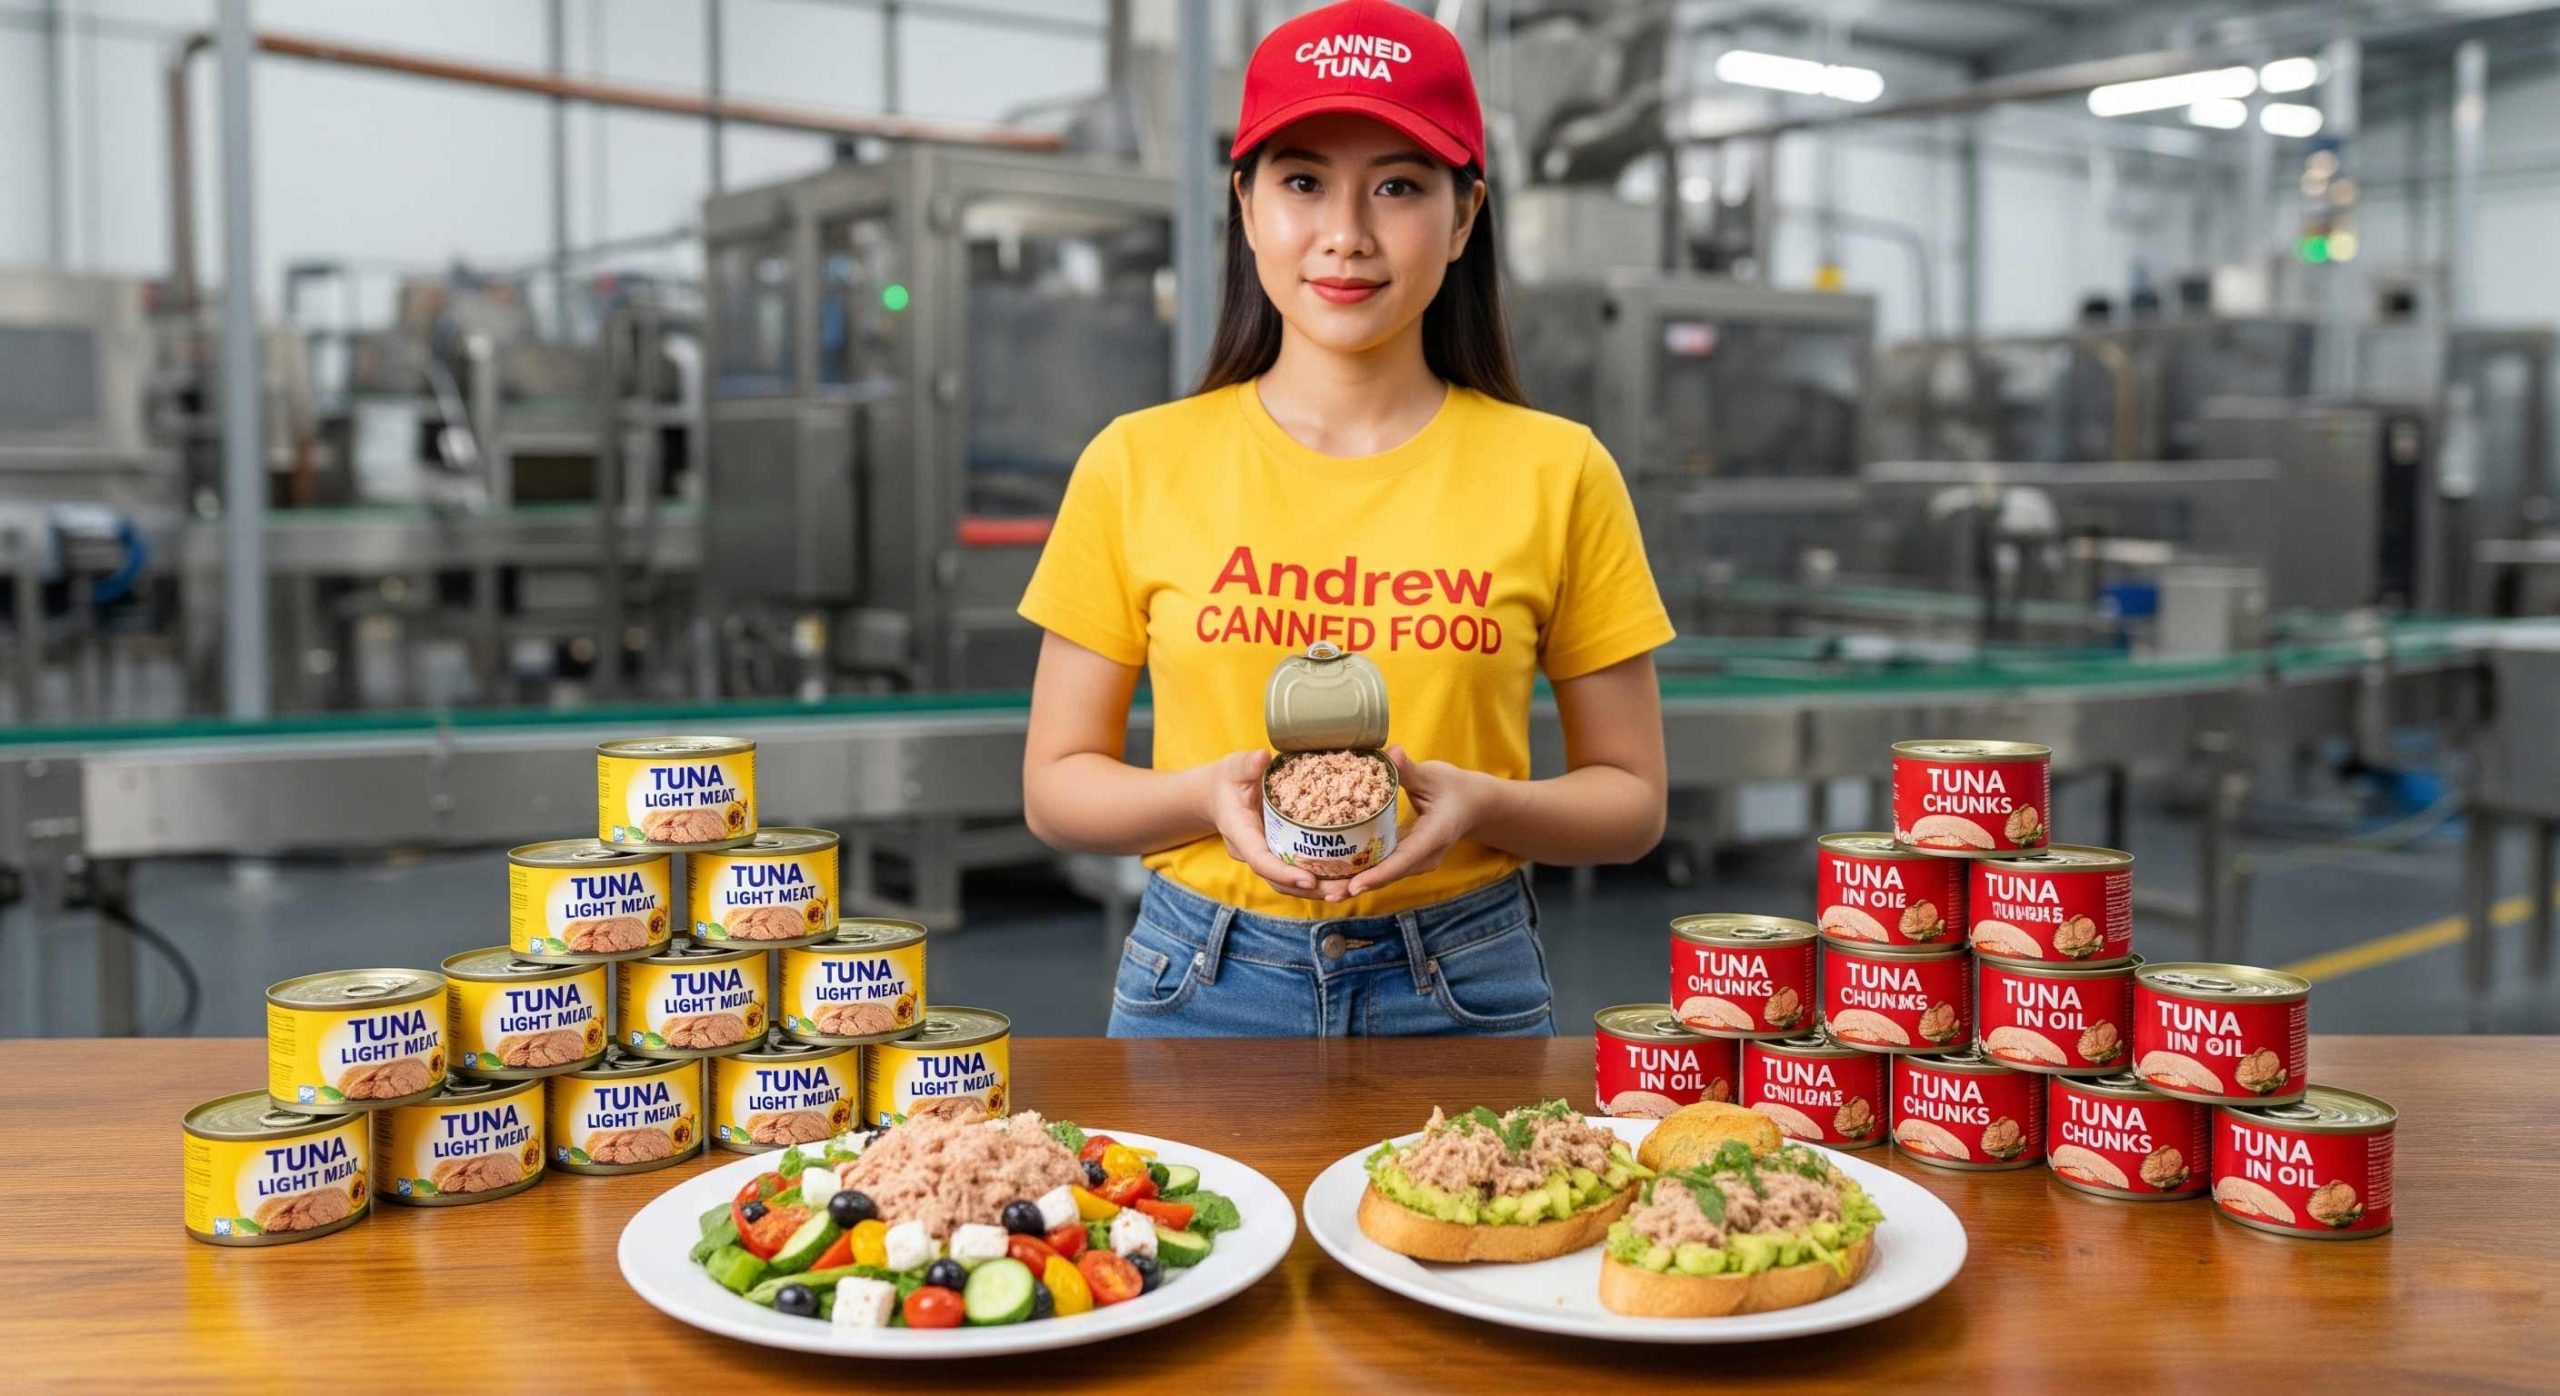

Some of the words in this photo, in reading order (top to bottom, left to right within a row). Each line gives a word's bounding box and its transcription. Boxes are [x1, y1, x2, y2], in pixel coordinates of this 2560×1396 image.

[1295, 34, 1412, 63] CANNED
[1313, 57, 1392, 82] TUNA
[1209, 546, 1492, 607] Andrew
[1196, 605, 1375, 652] CANNED
[1390, 614, 1502, 654] FOOD
[650, 765, 724, 790] TUNA
[1927, 768, 2005, 794] TUNA
[645, 792, 694, 808] LIGHT
[1923, 794, 2012, 814] CHUNKS
[1300, 831, 1346, 848] TUNA
[570, 872, 644, 900] TUNA
[731, 863, 804, 887] TUNA
[1832, 860, 1904, 889] TUNA
[726, 890, 772, 905] LIGHT
[778, 886, 816, 902] MEAT
[1842, 890, 1865, 905] IN
[1985, 873, 2059, 903] TUNA
[565, 901, 615, 919] LIGHT
[821, 959, 893, 983] TUNA
[1695, 950, 1768, 978] TUNA
[1846, 962, 1922, 992] TUNA
[671, 968, 743, 995] TUNA
[816, 985, 862, 1000] LIGHT
[869, 981, 904, 997] MEAT
[2002, 979, 2082, 1009] TUNA
[505, 984, 582, 1013] TUNA
[664, 997, 715, 1014] LIGHT
[347, 1010, 427, 1043] TUNA
[500, 1014, 552, 1032] LIGHT
[2016, 1008, 2043, 1027] IN
[2049, 1011, 2087, 1030] OIL
[2157, 1000, 2242, 1036] TUNA
[341, 1043, 399, 1064] LIGHT
[1626, 1045, 1700, 1072] TUNA
[2205, 1037, 2246, 1058] OIL
[917, 1052, 986, 1077] TUNA
[1762, 1056, 1836, 1088] TUNA
[756, 1067, 830, 1092] TUNA
[911, 1081, 958, 1095] LIGHT
[1640, 1072, 1665, 1090] IN
[1670, 1073, 1706, 1090] OIL
[1909, 1071, 1984, 1103] TUNA
[594, 1082, 670, 1110] TUNA
[750, 1095, 798, 1110] LIGHT
[440, 1105, 519, 1138] TUNA
[587, 1111, 639, 1128] LIGHT
[1903, 1098, 1990, 1125] CHUNKS
[2068, 1095, 2147, 1132] TUNA
[434, 1137, 490, 1158] LIGHT
[2062, 1122, 2152, 1154] CHUNKS
[2231, 1124, 2313, 1165] TUNA
[265, 1137, 348, 1173] TUNA
[258, 1172, 318, 1195] LIGHT
[2245, 1159, 2272, 1182] IN
[2279, 1165, 2320, 1188] OIL
